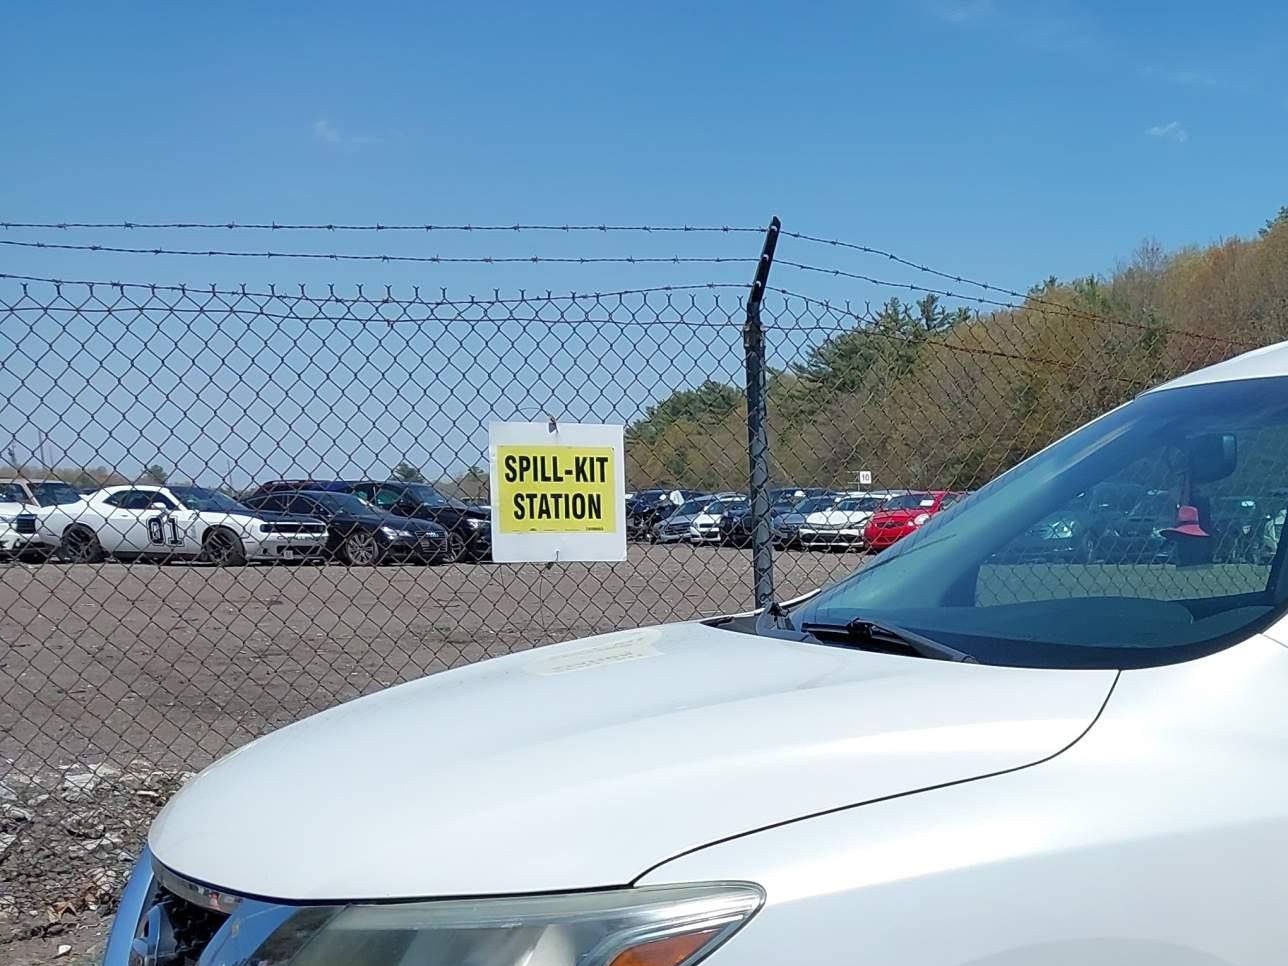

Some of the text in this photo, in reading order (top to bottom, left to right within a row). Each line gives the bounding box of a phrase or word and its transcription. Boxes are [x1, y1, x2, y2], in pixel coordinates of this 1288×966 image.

[504, 455, 609, 483] SPILL-KIT
[513, 493, 602, 520] STATION
[146, 514, 185, 547] 01
